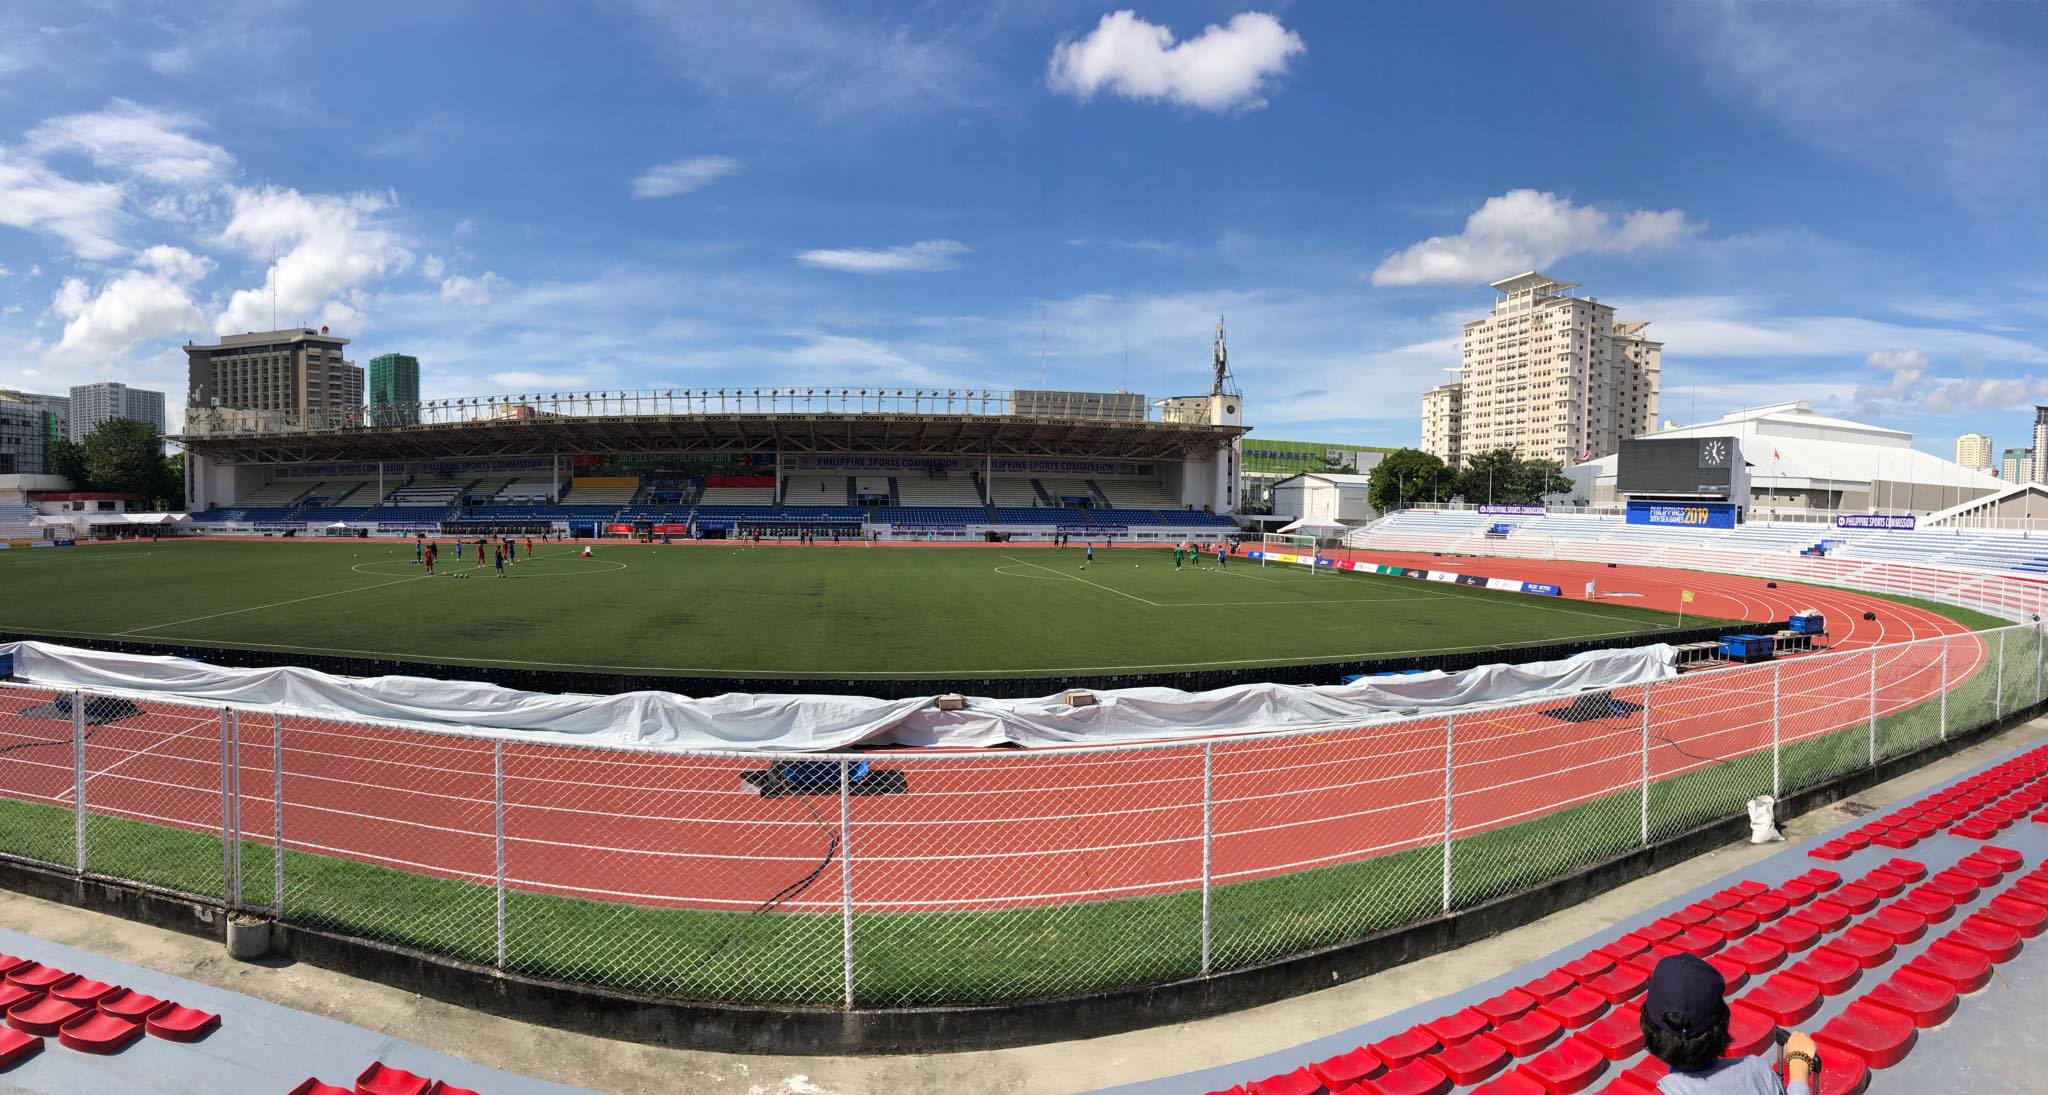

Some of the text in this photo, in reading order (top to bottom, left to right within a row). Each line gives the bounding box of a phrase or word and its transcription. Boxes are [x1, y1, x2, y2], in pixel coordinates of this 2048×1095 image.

[492, 460, 542, 470] COMMISSION
[817, 456, 864, 467] PHILIPPINE
[868, 457, 900, 468] SPORTS
[1030, 461, 1059, 470] SPORTS
[1061, 462, 1114, 472] COMMISSION
[1650, 506, 1684, 516] PHILIPPINES
[1684, 508, 1708, 524] 2019
[1846, 516, 1869, 526] PHILIPPINE
[1869, 517, 1885, 527] SPORTS
